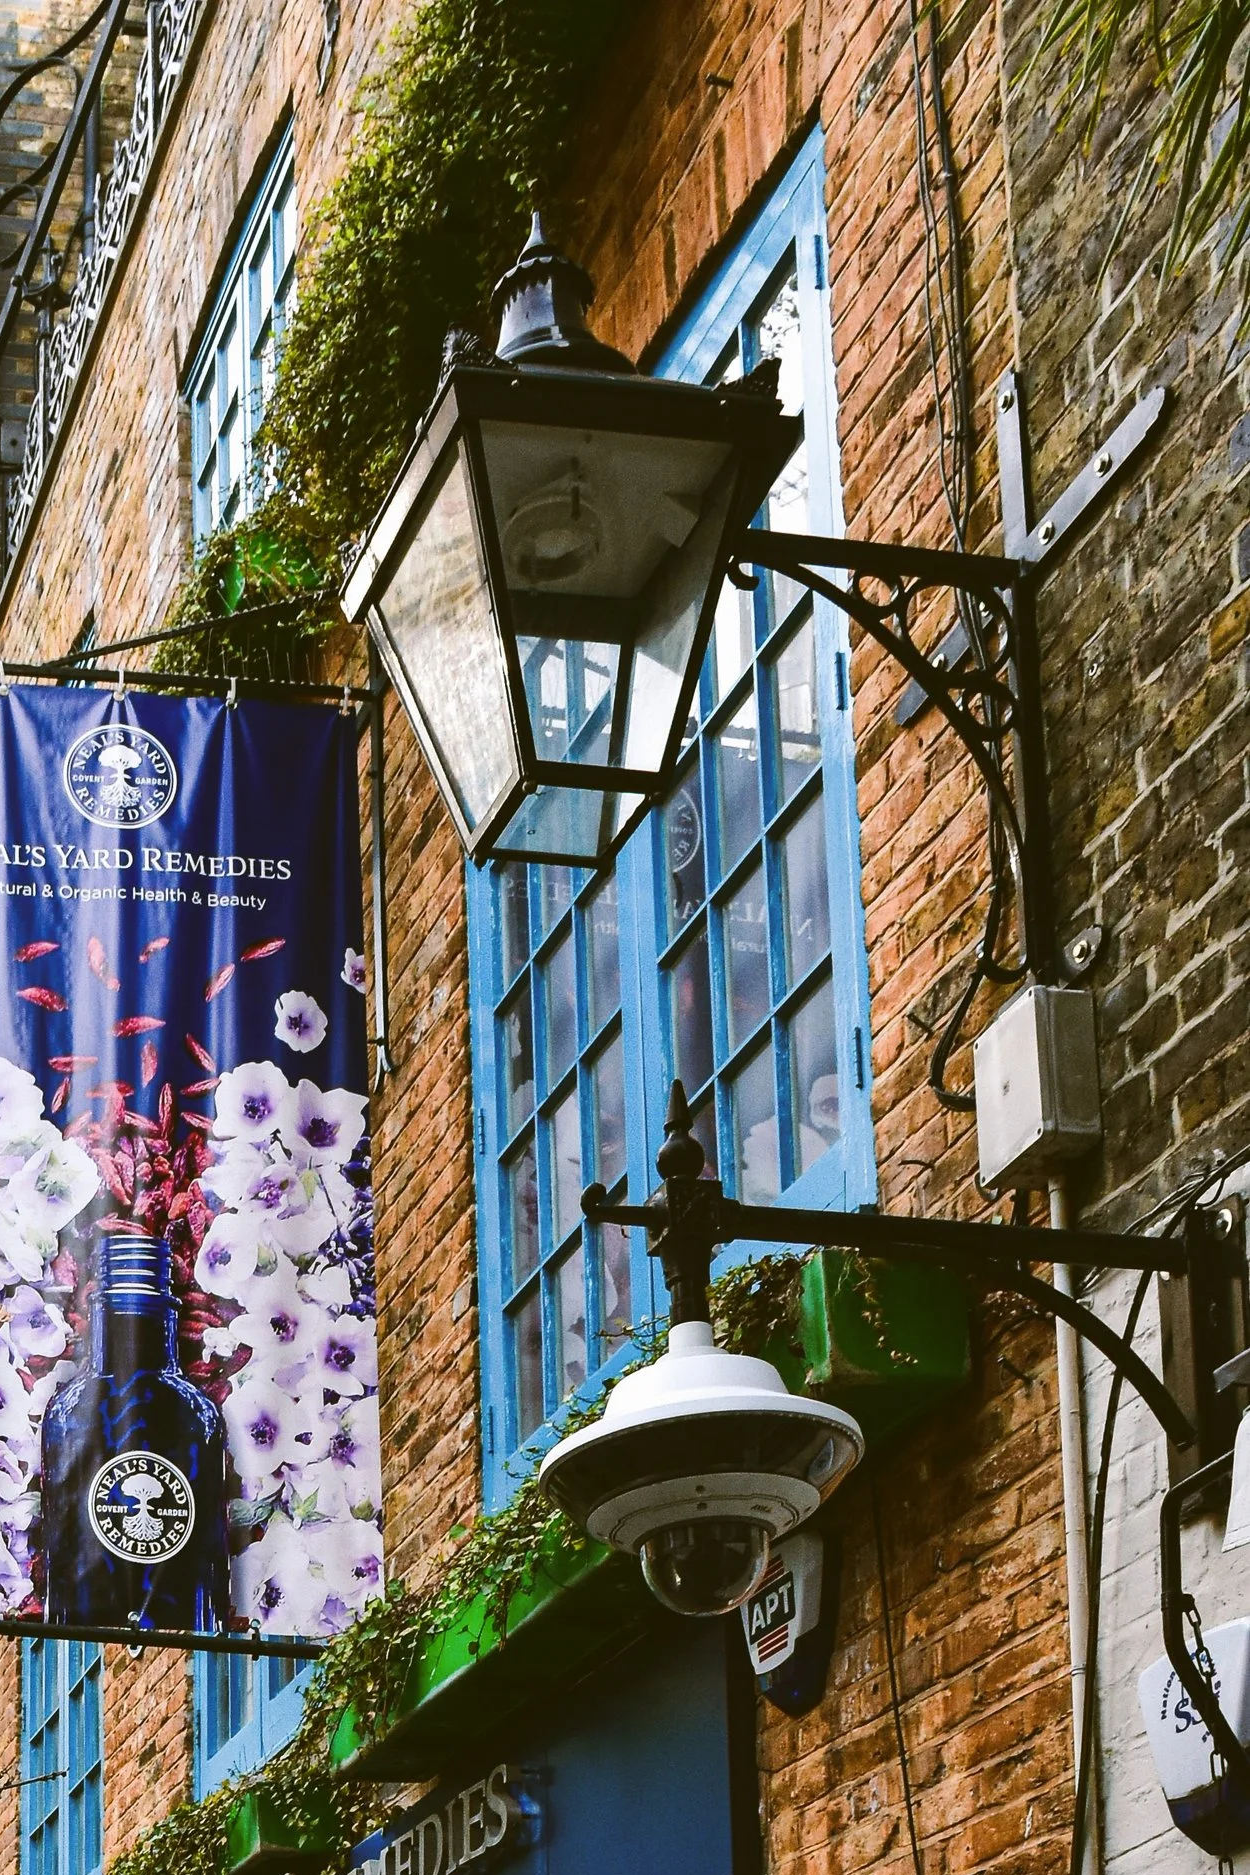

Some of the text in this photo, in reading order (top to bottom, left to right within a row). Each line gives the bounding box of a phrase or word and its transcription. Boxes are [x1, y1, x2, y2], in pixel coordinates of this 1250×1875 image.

[73, 731, 167, 774] NEAL'S YARD
[72, 774, 168, 786] COVENT GARDEN
[76, 786, 165, 821] REMEDIES
[52, 845, 134, 870] YARD
[141, 847, 292, 880] REMEDIES
[42, 884, 53, 898] &
[59, 885, 127, 902] Organic
[132, 886, 186, 903] Health
[192, 891, 202, 905] &
[207, 893, 266, 911] Beauty
[97, 1459, 187, 1505] NEAL'S YARD
[96, 1505, 188, 1517] COVENT GARDEN
[100, 1517, 185, 1555] REMEDIES
[751, 1581, 792, 1636] APT
